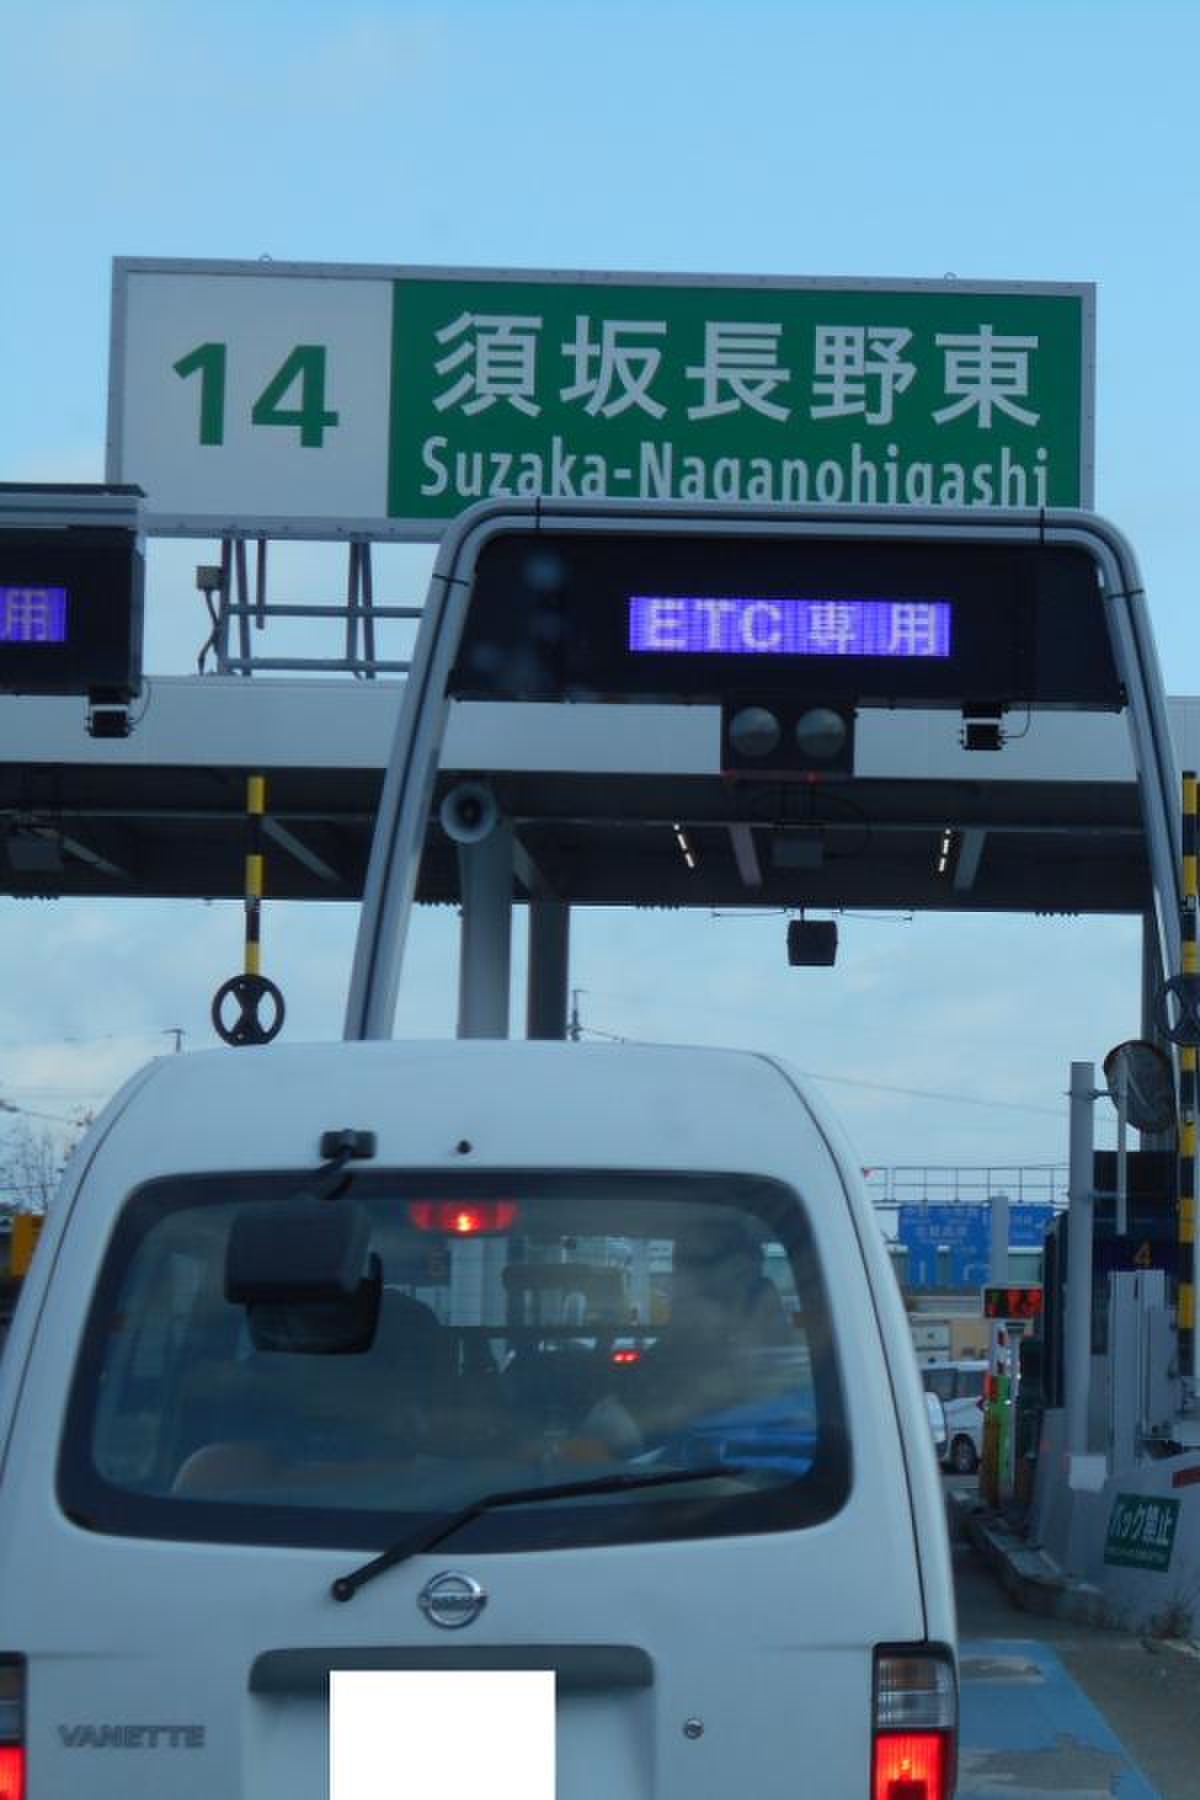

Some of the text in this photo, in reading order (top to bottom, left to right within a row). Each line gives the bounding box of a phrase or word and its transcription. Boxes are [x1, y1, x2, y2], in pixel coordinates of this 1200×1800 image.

[172, 342, 340, 449] 14
[432, 311, 1041, 429] 須坂長野東
[420, 435, 1047, 508] Suzaka-Naganohigashi
[57, 1725, 206, 1748] VANETTE
